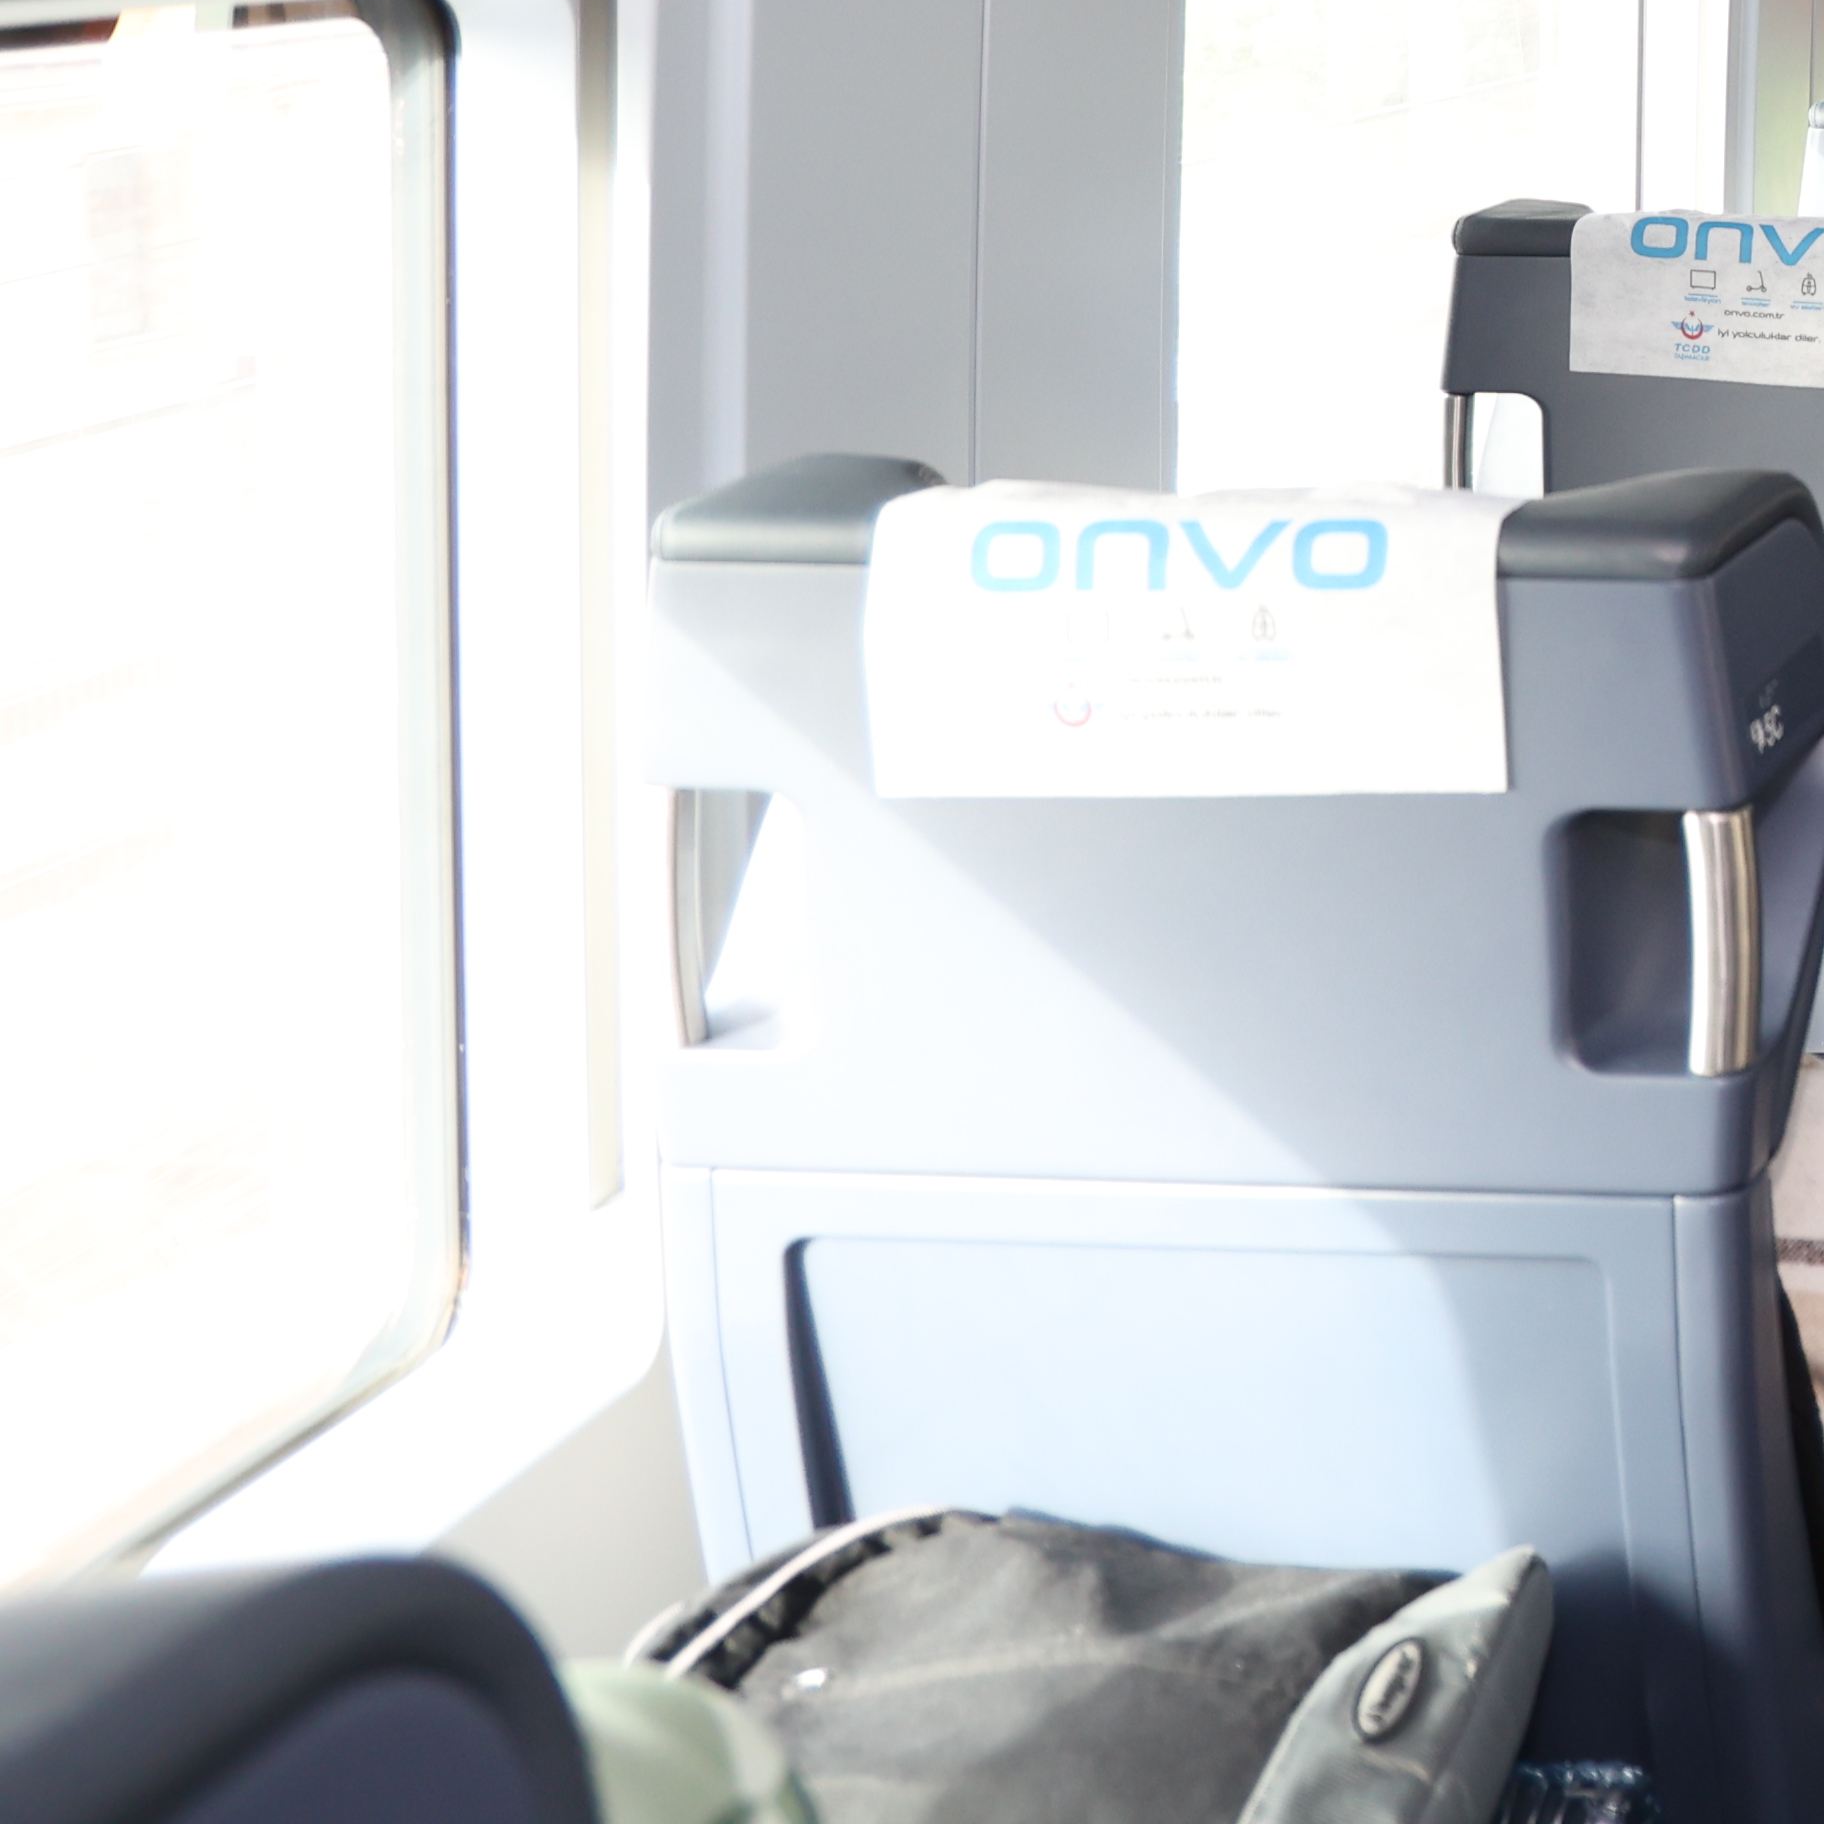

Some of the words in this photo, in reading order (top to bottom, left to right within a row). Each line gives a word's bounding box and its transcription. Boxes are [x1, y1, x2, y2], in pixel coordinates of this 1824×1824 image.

[1724, 309, 1784, 320] onvo.com.tr
[1674, 343, 1711, 354] TCDD
[970, 519, 1389, 593] onvo
